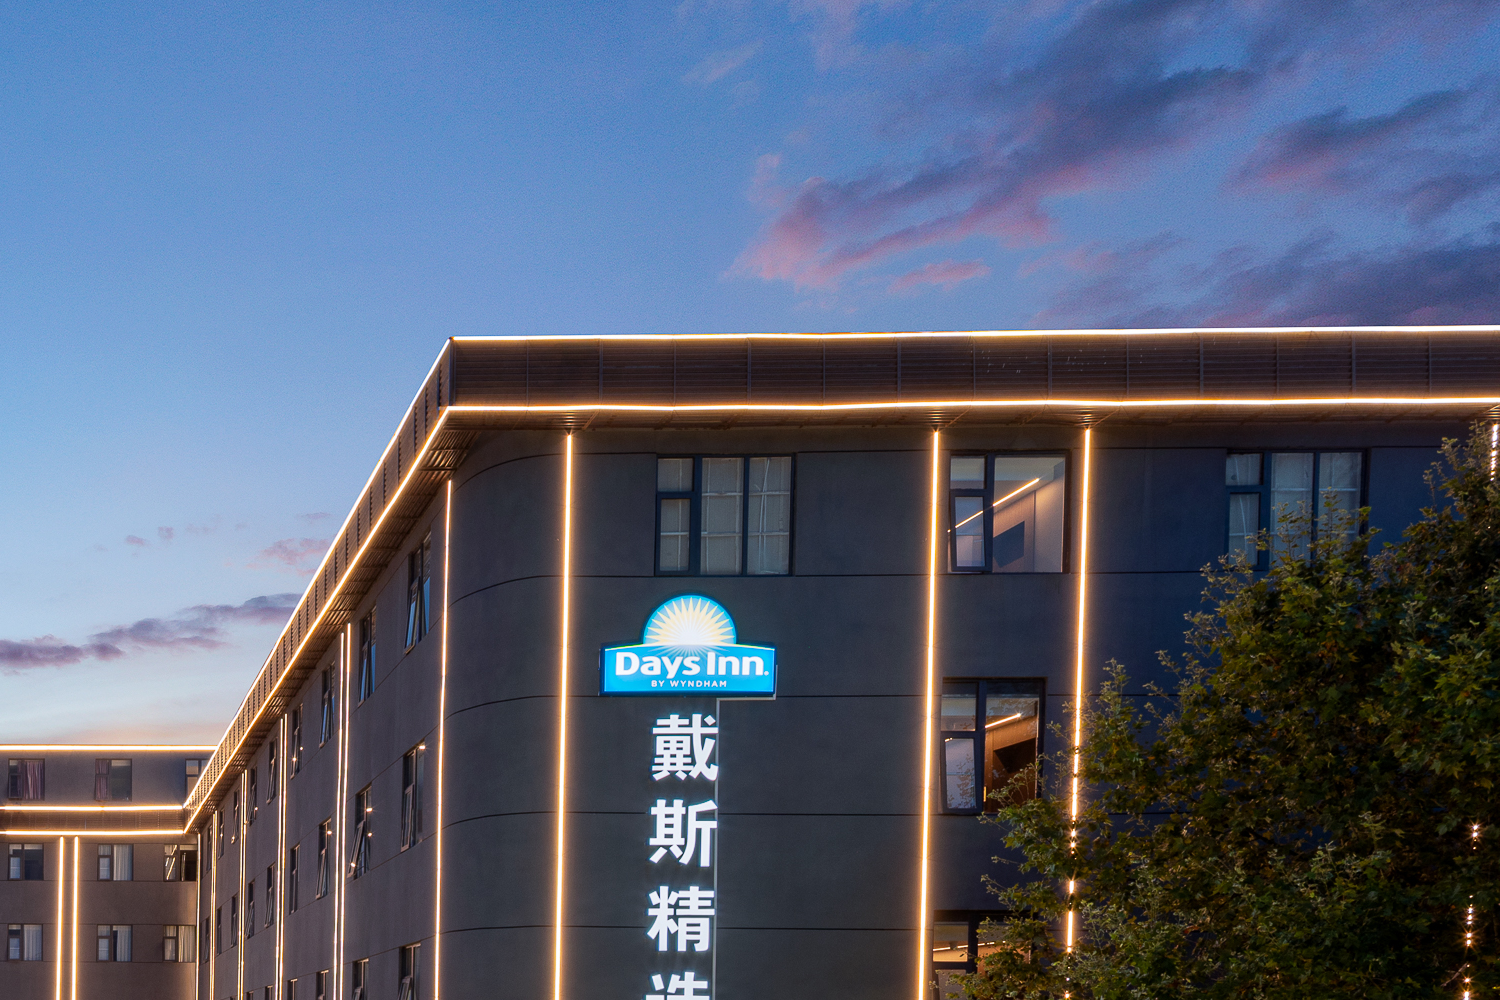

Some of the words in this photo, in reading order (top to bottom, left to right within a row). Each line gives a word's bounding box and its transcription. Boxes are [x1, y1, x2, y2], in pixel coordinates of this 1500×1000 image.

[615, 651, 700, 679] Days
[706, 651, 764, 676] Inn
[651, 680, 665, 688] BY
[669, 680, 727, 688] WYNDHAM
